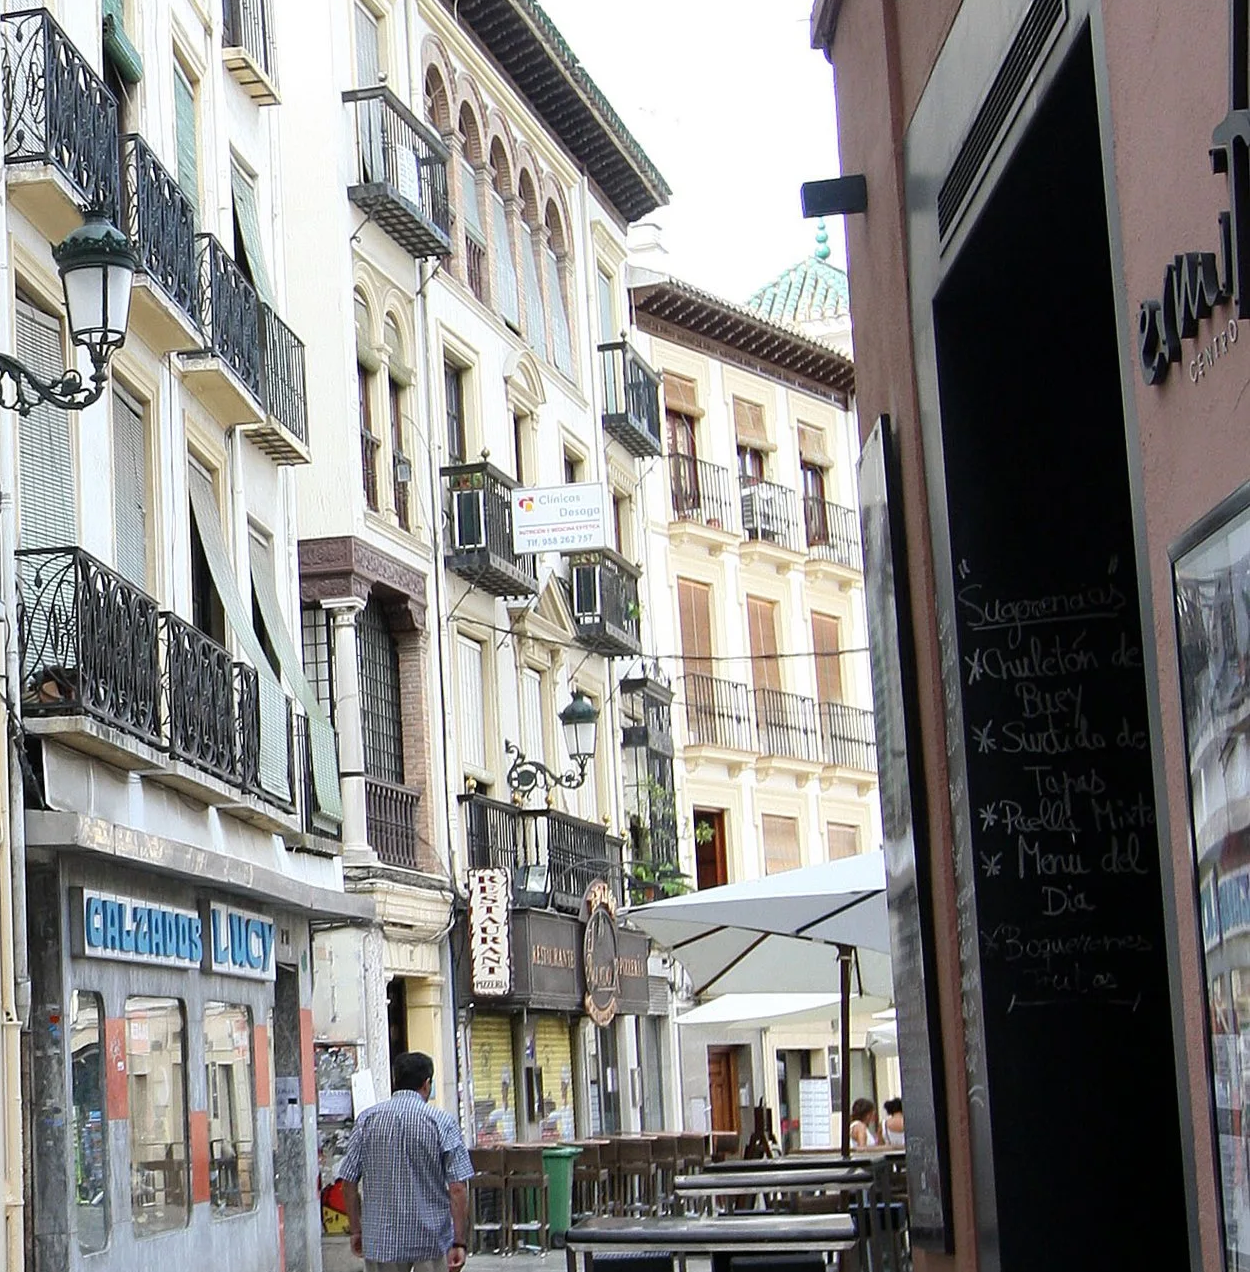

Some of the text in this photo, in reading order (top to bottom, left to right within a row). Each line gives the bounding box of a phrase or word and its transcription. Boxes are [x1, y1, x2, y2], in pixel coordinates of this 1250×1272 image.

[1189, 318, 1239, 383] CENTRO
[982, 628, 1140, 680] Chuletón de
[1015, 680, 1083, 727] Buey
[1002, 713, 1106, 754] Surtido
[1023, 764, 1106, 819] Tapas
[1101, 831, 1149, 875] del
[85, 897, 276, 973] CALZADOS LUCY
[478, 875, 501, 975] RESTAURANT
